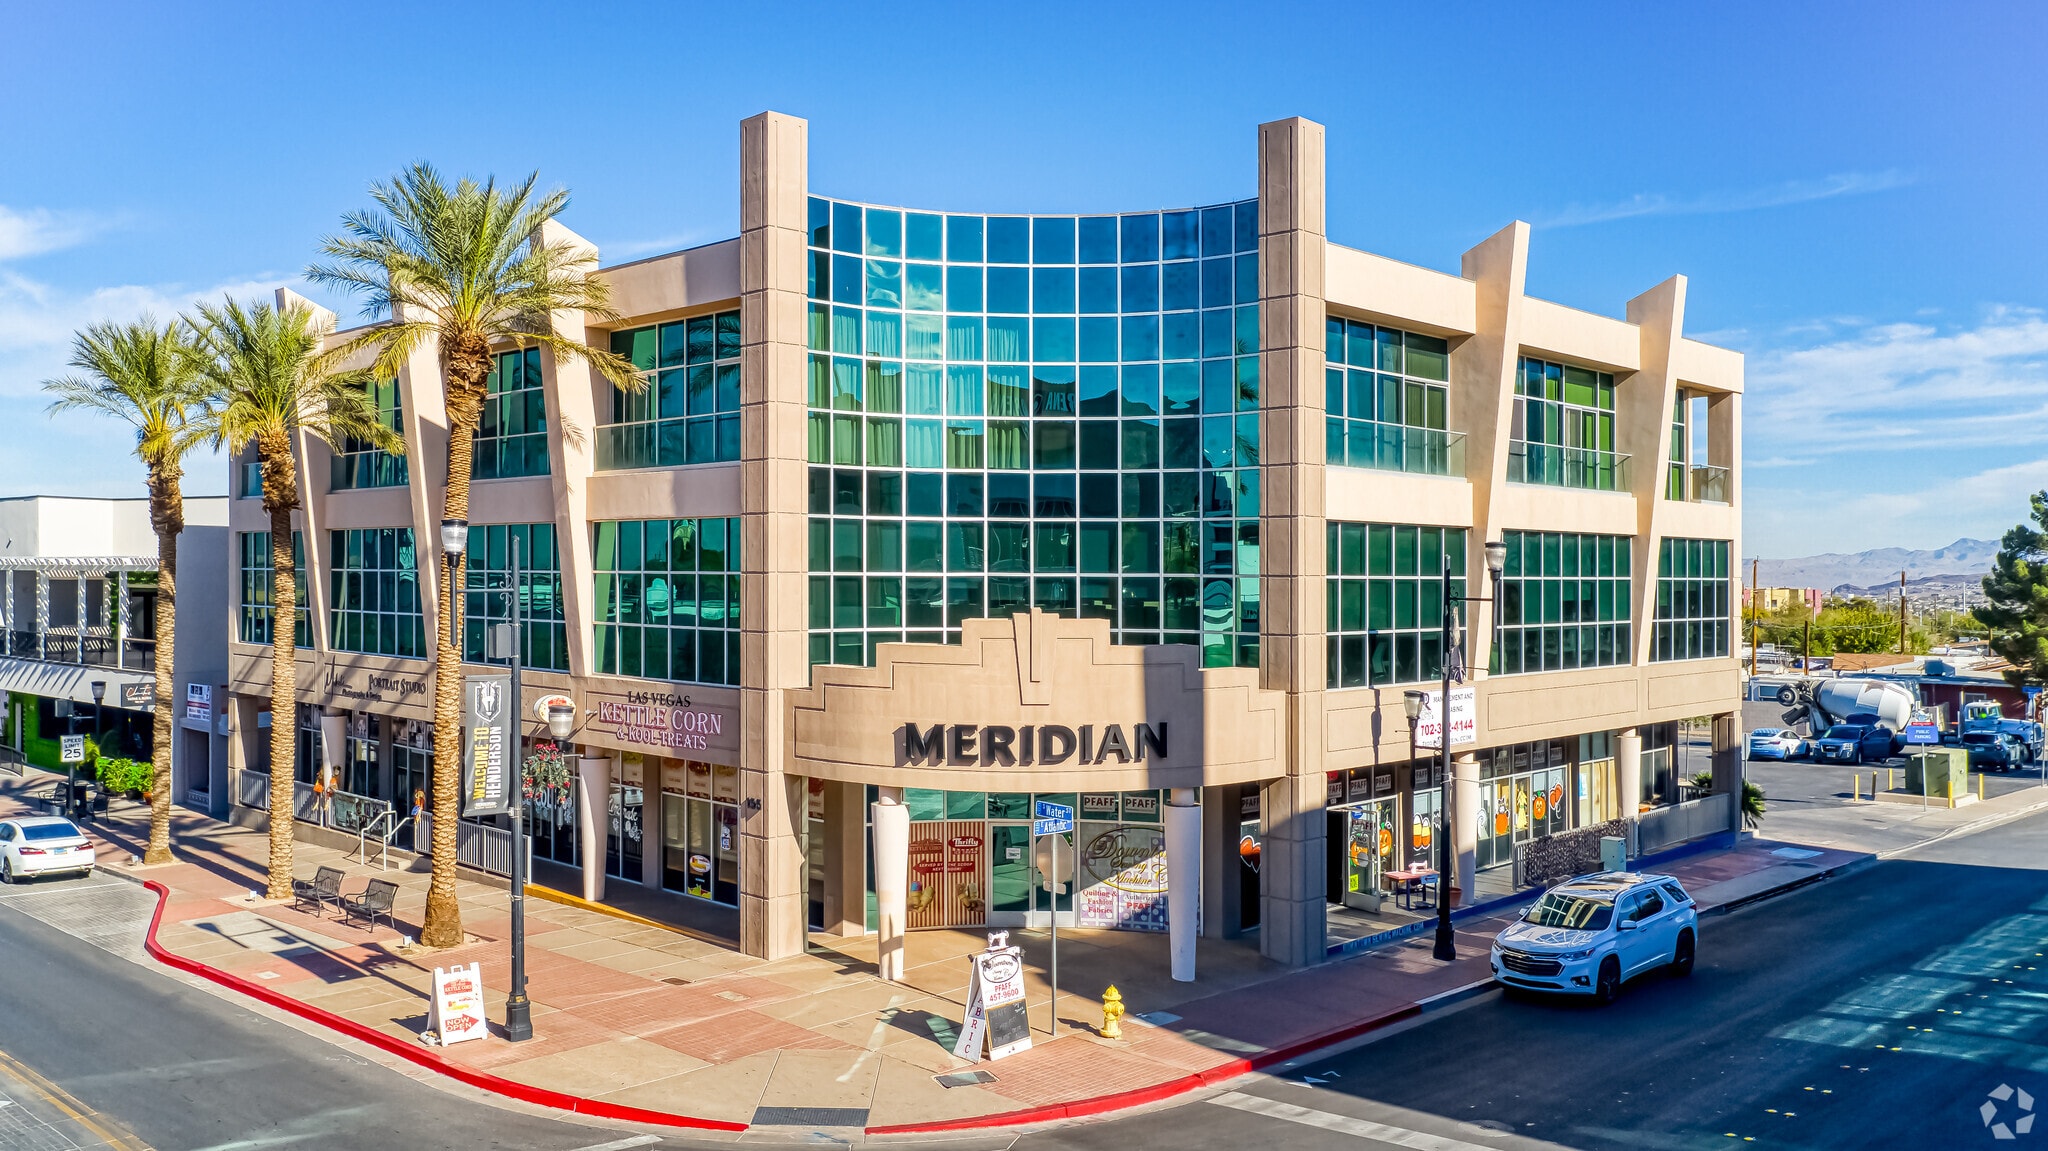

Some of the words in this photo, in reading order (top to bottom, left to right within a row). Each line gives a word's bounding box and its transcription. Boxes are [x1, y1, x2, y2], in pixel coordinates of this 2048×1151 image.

[368, 674, 399, 692] PORTRAIT
[400, 679, 426, 696] STUDIO
[628, 691, 648, 705] LAS
[651, 692, 691, 707] VEGAS
[599, 701, 667, 729] KETTLE
[672, 709, 721, 735] CORN
[474, 727, 489, 742] TO
[617, 728, 625, 739] &
[629, 727, 657, 745] KOOL
[660, 731, 707, 750] TREATS
[900, 722, 1168, 763] MERIDIAN
[64, 749, 82, 759] 25
[486, 726, 502, 799] HENDERSON
[473, 744, 489, 800] WELCOME
[1328, 783, 1342, 792] FAFF
[1351, 780, 1366, 791] PFAFF
[1084, 797, 1115, 806] PFAFF
[1125, 799, 1156, 808] PFAFF
[1046, 804, 1065, 818] Water
[1044, 820, 1067, 832] Atlantic
[953, 837, 979, 847] Thrifty
[1109, 869, 1152, 885] Machine
[994, 982, 1012, 992] PFAFF
[990, 988, 1019, 1002] 457-9600
[446, 1022, 472, 1032] OPEN
[447, 1017, 470, 1025] NOW
